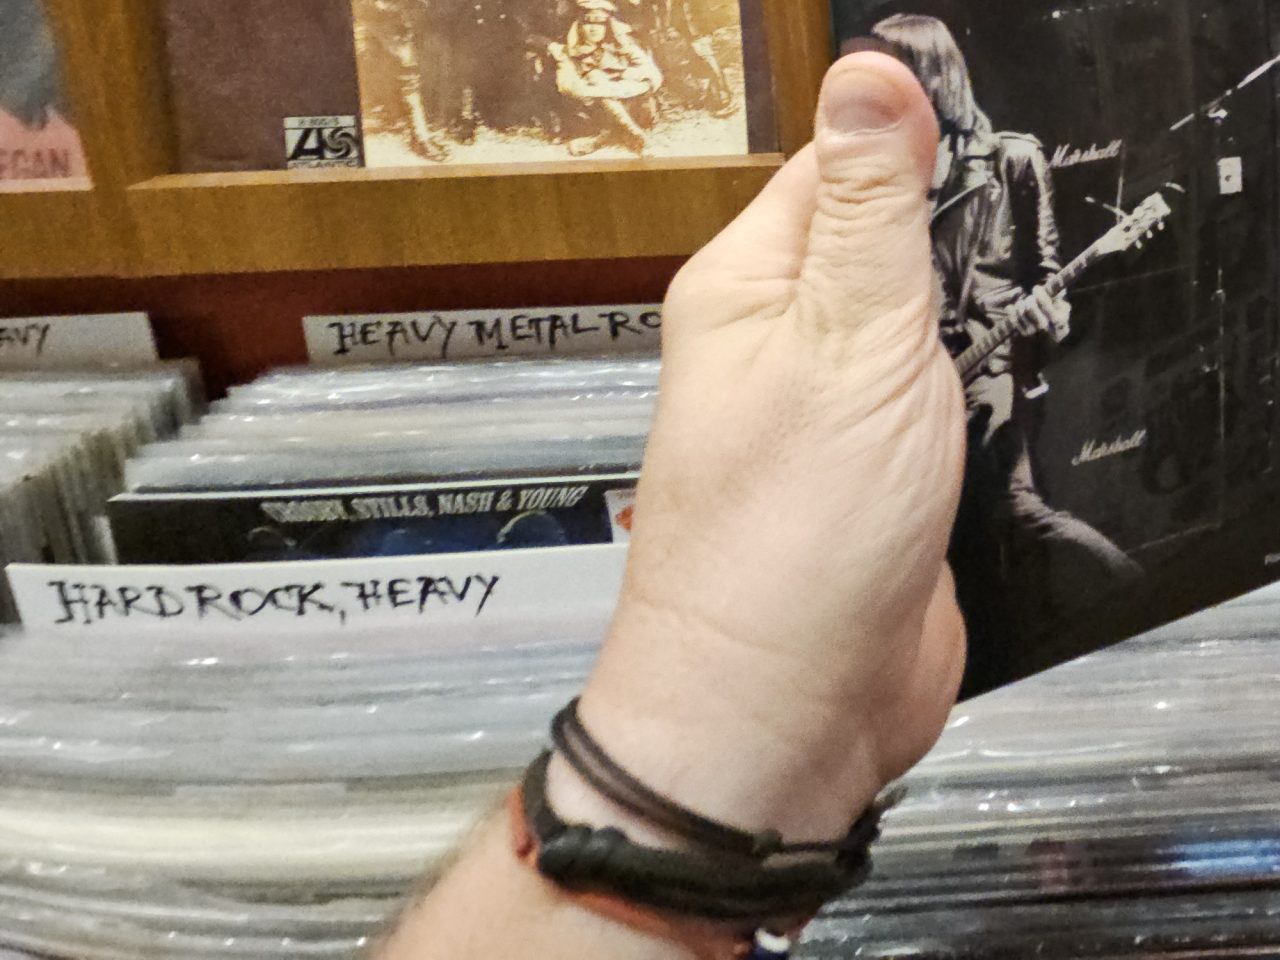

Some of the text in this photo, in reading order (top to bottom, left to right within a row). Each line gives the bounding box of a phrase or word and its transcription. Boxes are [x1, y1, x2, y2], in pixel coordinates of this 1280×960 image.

[328, 315, 456, 358] HEAVY
[466, 312, 598, 351] METAL
[1071, 428, 1147, 467] Marshall
[350, 492, 434, 520] STILLS,
[437, 491, 495, 515] NASH
[496, 493, 513, 512] &
[515, 485, 590, 511] YOUNG
[47, 579, 184, 626] HARD
[342, 575, 500, 616] HEAVY
